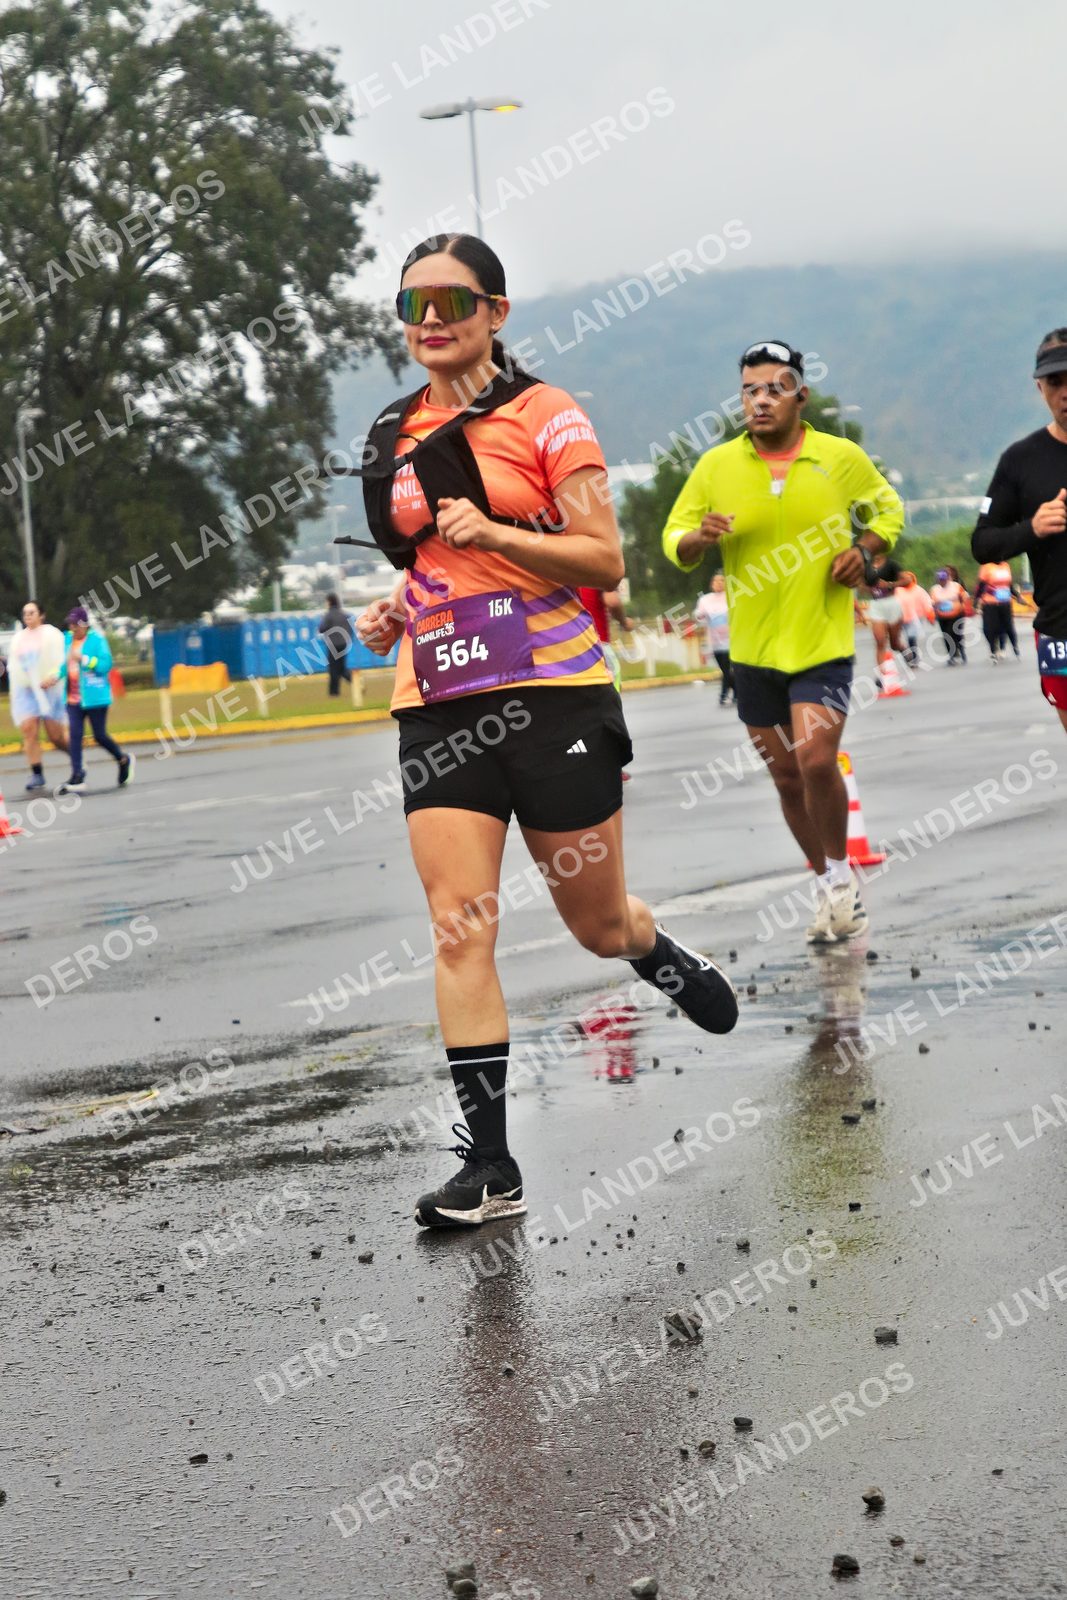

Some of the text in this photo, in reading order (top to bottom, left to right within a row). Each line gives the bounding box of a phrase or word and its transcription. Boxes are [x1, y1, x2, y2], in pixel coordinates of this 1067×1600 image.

[488, 597, 514, 618] 15K
[416, 609, 454, 635] CARRERA
[416, 628, 446, 645] OMNILIFE
[435, 636, 489, 672] 564
[1047, 640, 1067, 660] 13
